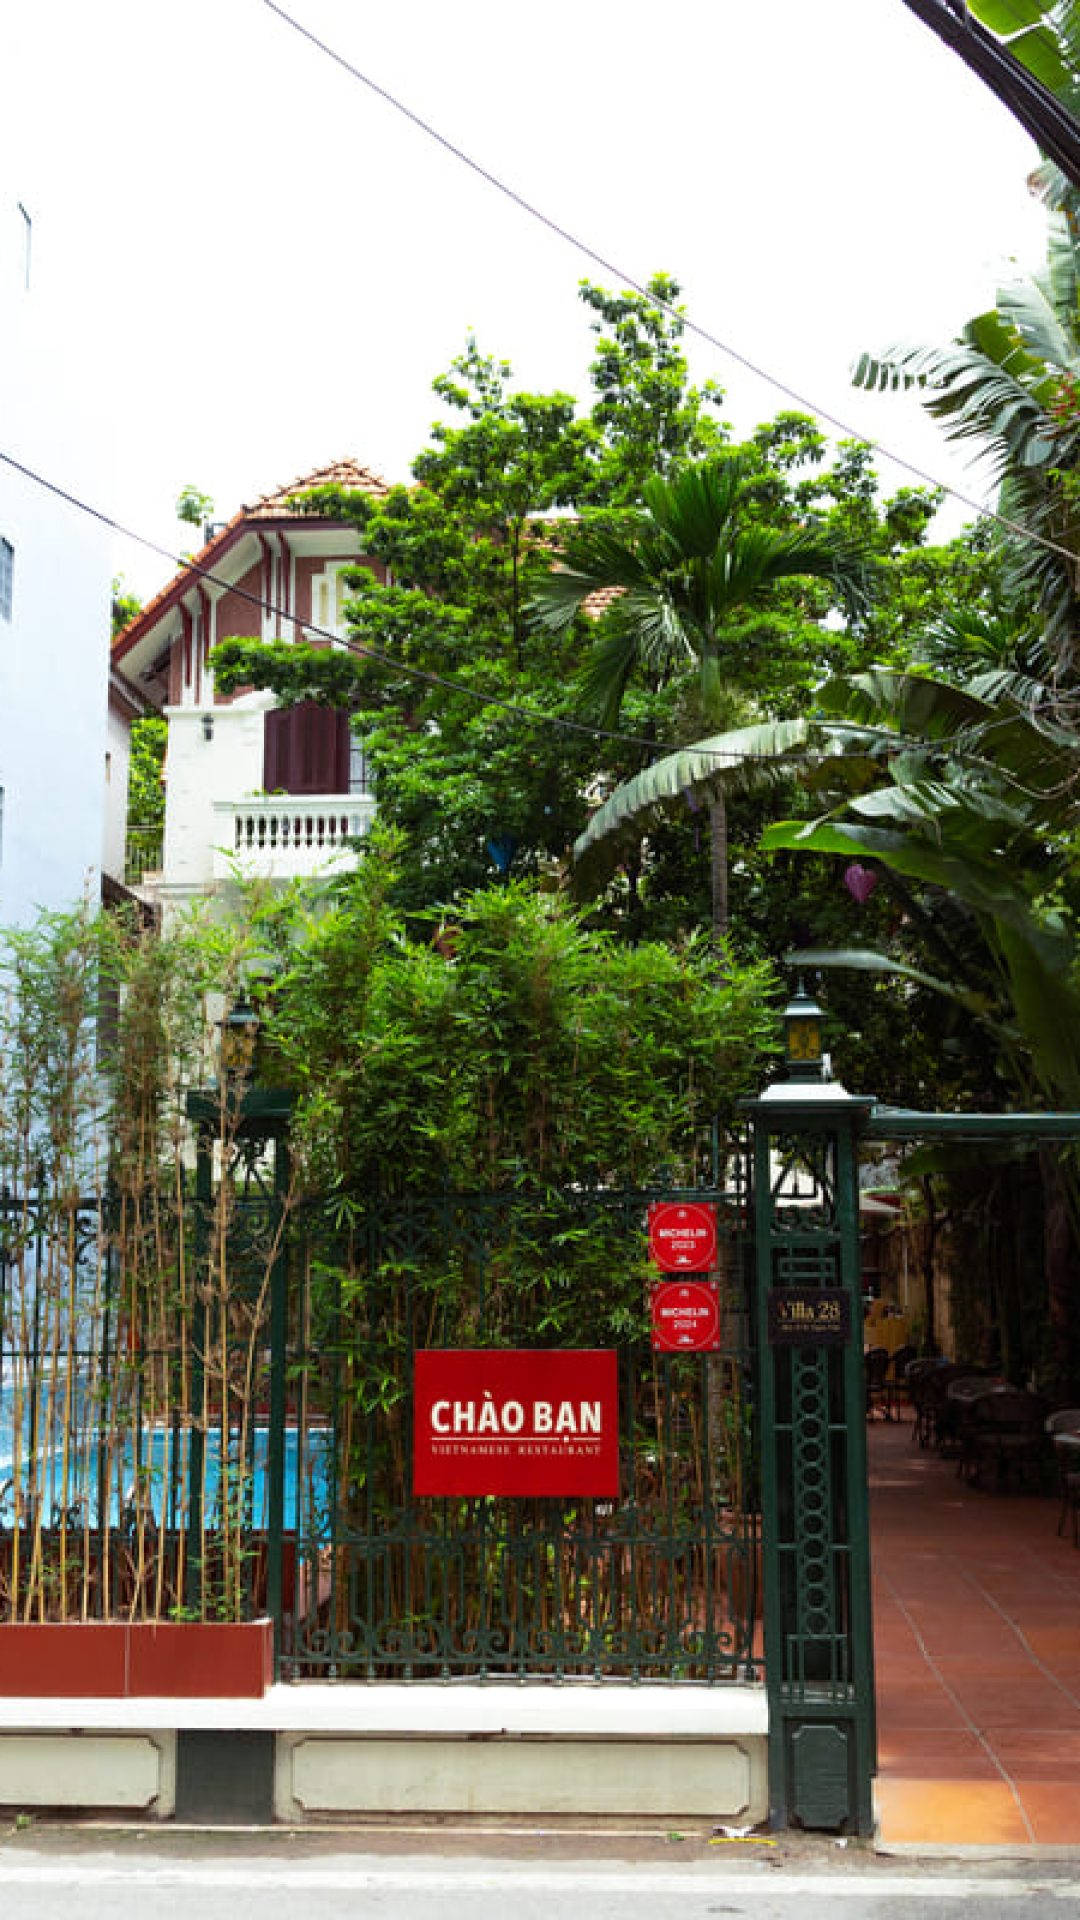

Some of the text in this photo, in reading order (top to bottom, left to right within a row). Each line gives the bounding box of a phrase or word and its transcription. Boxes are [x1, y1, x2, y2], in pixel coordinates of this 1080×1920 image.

[659, 1227, 708, 1238] MICHELIN
[660, 1307, 710, 1318] MICHELIN
[430, 1389, 525, 1434] CHÀO
[431, 1443, 602, 1456] VIETNAMESE RESTAURANT
